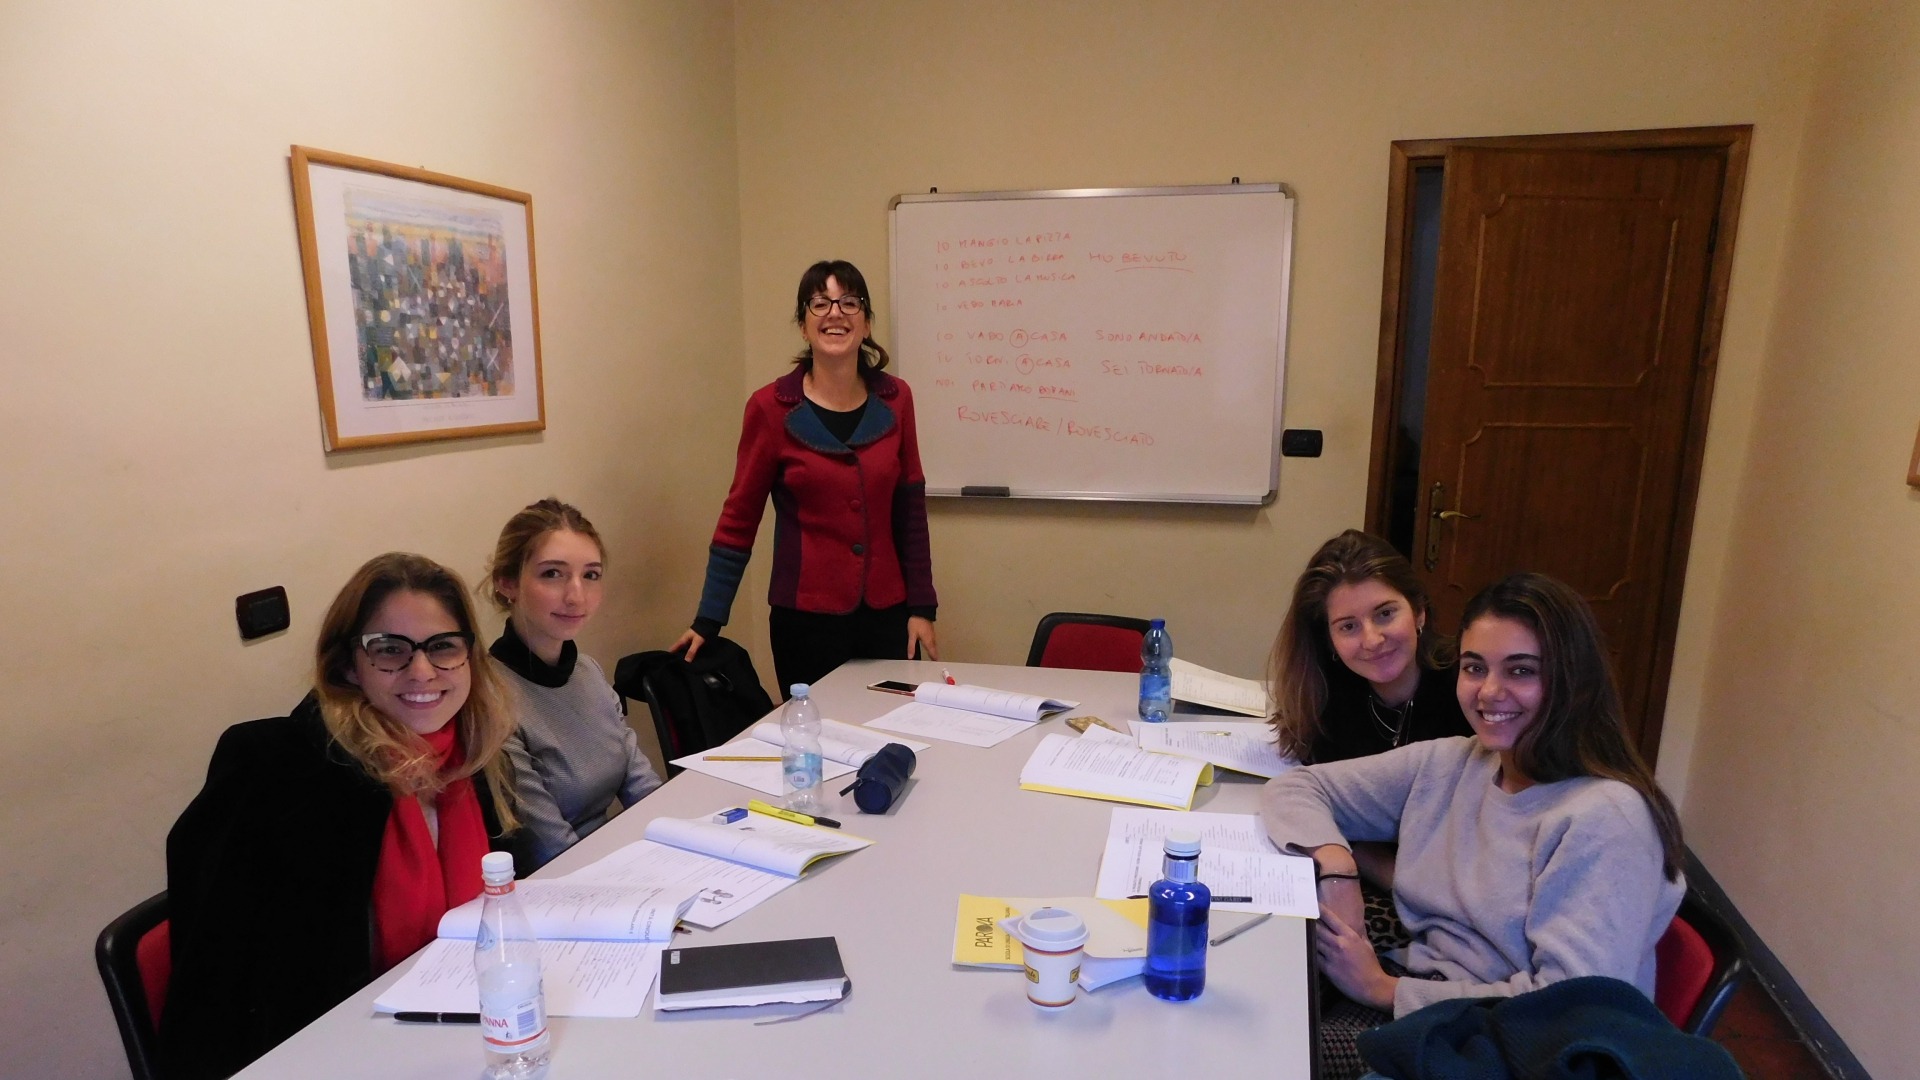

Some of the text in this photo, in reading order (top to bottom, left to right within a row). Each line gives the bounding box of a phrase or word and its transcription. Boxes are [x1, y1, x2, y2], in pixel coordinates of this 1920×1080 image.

[959, 238, 1008, 248] MANGIO
[1016, 236, 1031, 245] LA
[1036, 231, 1071, 243] PIZZA
[1089, 252, 1188, 263] HO BEVUTO
[960, 258, 994, 269] BEVO
[1015, 274, 1031, 283] LA
[1036, 273, 1076, 281] MUSICA
[967, 331, 1004, 341] VADO
[1030, 331, 1068, 342] CASA
[1096, 330, 1132, 341] SONO
[1036, 357, 1071, 368] CASA
[1101, 360, 1128, 375] SEI
[958, 406, 1051, 432] ROVESCIARE
[1067, 420, 1155, 446] ROVESCIATO
